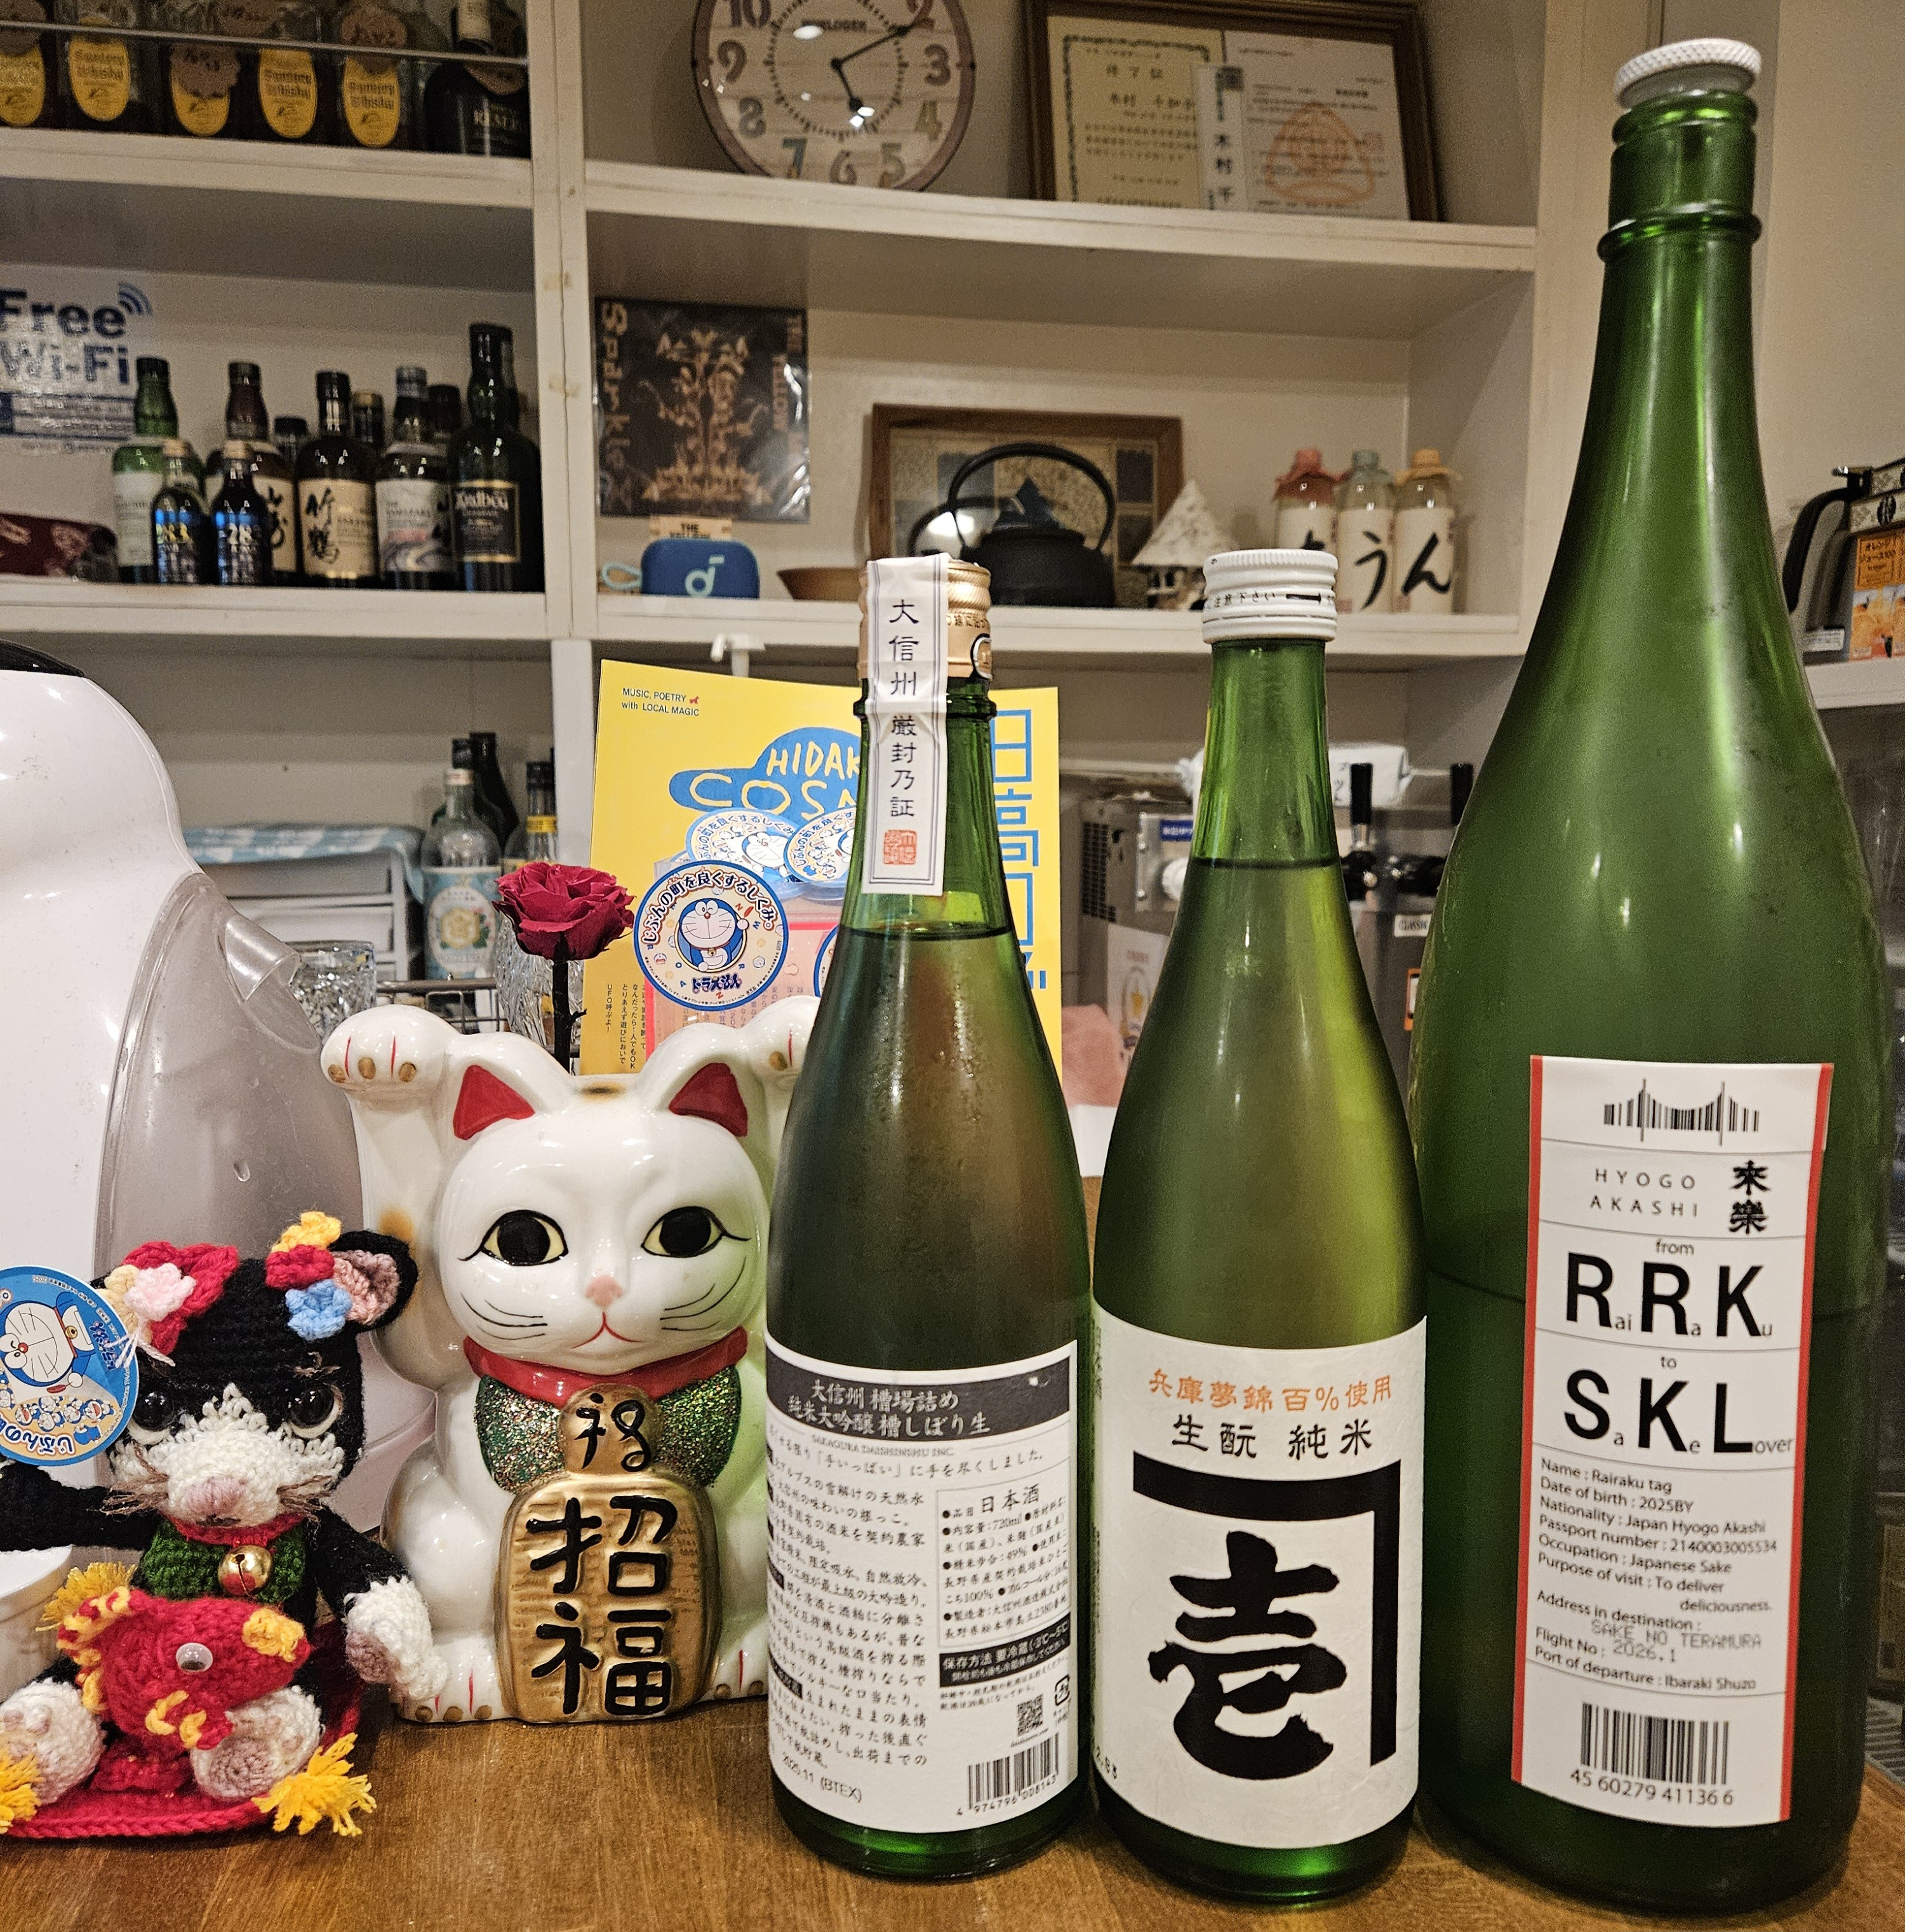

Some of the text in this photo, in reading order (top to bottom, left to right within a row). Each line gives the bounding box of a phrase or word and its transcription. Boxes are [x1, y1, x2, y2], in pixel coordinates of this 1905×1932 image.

[717, 39, 747, 83] 9
[923, 44, 949, 86] 3
[738, 96, 766, 138] 8
[914, 100, 942, 142] 4
[782, 137, 807, 180] 7
[828, 149, 857, 185] 6
[880, 142, 906, 185] 5
[0, 288, 126, 338] Free
[0, 340, 130, 385] Wi-Fi
[1354, 530, 1387, 611] う
[1401, 531, 1452, 597] ん
[888, 598, 919, 697] 大信州
[621, 700, 700, 716] with LOCAL MAGIC
[622, 688, 687, 703] MUSIC, POETRY
[642, 870, 777, 945] じぶんの町を良くするしくみ。
[692, 973, 742, 994] ドラえもん
[1595, 1168, 1696, 1190] HYOGO
[1589, 1195, 1698, 1218] AKASHI
[1655, 1237, 1695, 1256] from
[1660, 1355, 1677, 1369] to
[787, 1394, 875, 1436] 純米大吟醸
[810, 1379, 959, 1414] 大信州 槽場詰め
[1287, 1417, 1374, 1461] 純米
[1540, 1476, 1695, 1514] Date of birth 2025BY
[1541, 1458, 1673, 1495] Name Rairaku tag
[980, 1482, 1040, 1514] 日本酒
[1539, 1495, 1767, 1537] Nationality Japan Hyogo Akashi
[1539, 1514, 1597, 1540] Passport
[1600, 1529, 1659, 1550] number
[1537, 1533, 1734, 1575] Occupation Japanese Sake
[1537, 1553, 1726, 1595] Purpose of visit To deliver
[525, 1496, 679, 1715] 招福
[1537, 1589, 1694, 1632] Address in destination
[1535, 1626, 1573, 1649] Flight
[1591, 1618, 1635, 1642] SAKE
[1681, 1632, 1762, 1651] TERAMURA
[1534, 1646, 1563, 1665] Port
[1566, 1657, 1581, 1669] of
[1582, 1661, 1655, 1686] departure
[1570, 1768, 1593, 1787] 45
[1598, 1778, 1657, 1801] 60279
